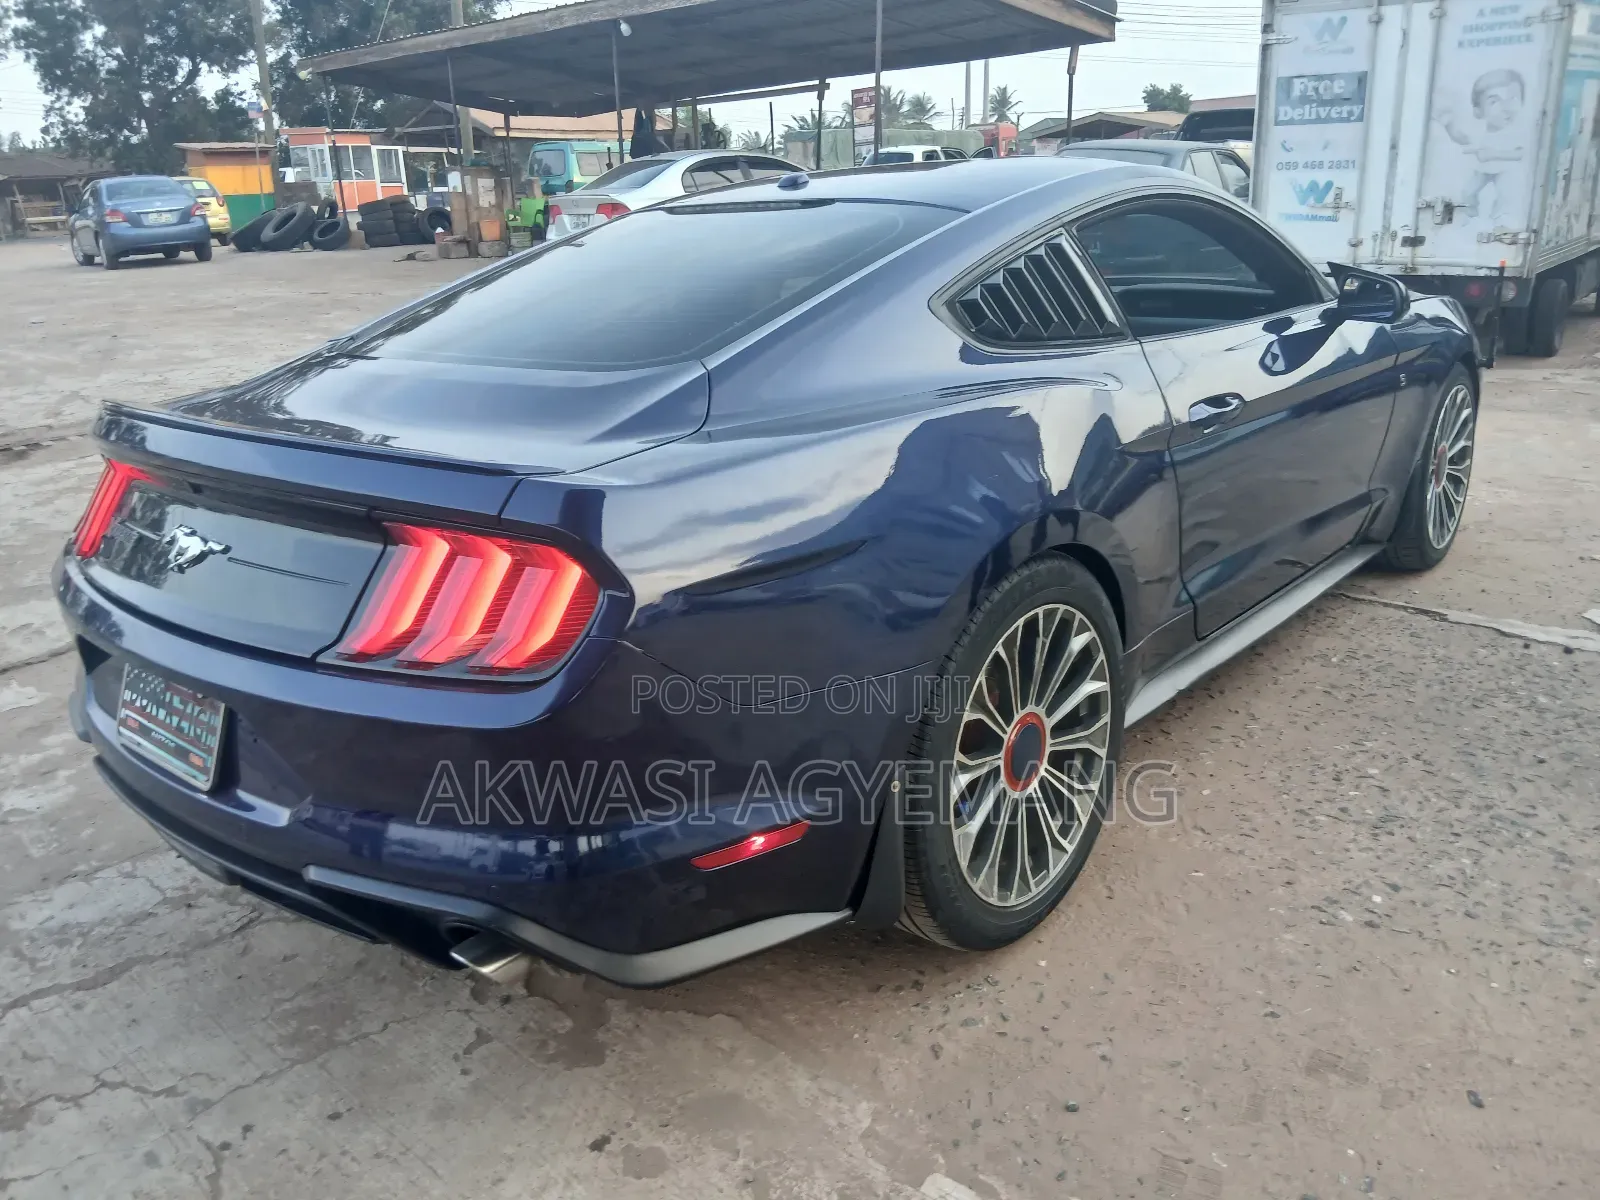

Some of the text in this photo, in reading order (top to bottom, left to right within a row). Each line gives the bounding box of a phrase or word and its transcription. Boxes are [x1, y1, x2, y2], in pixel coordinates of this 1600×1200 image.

[1293, 77, 1346, 98] Free
[1277, 103, 1364, 121] Delivery
[1276, 161, 1299, 171] 059
